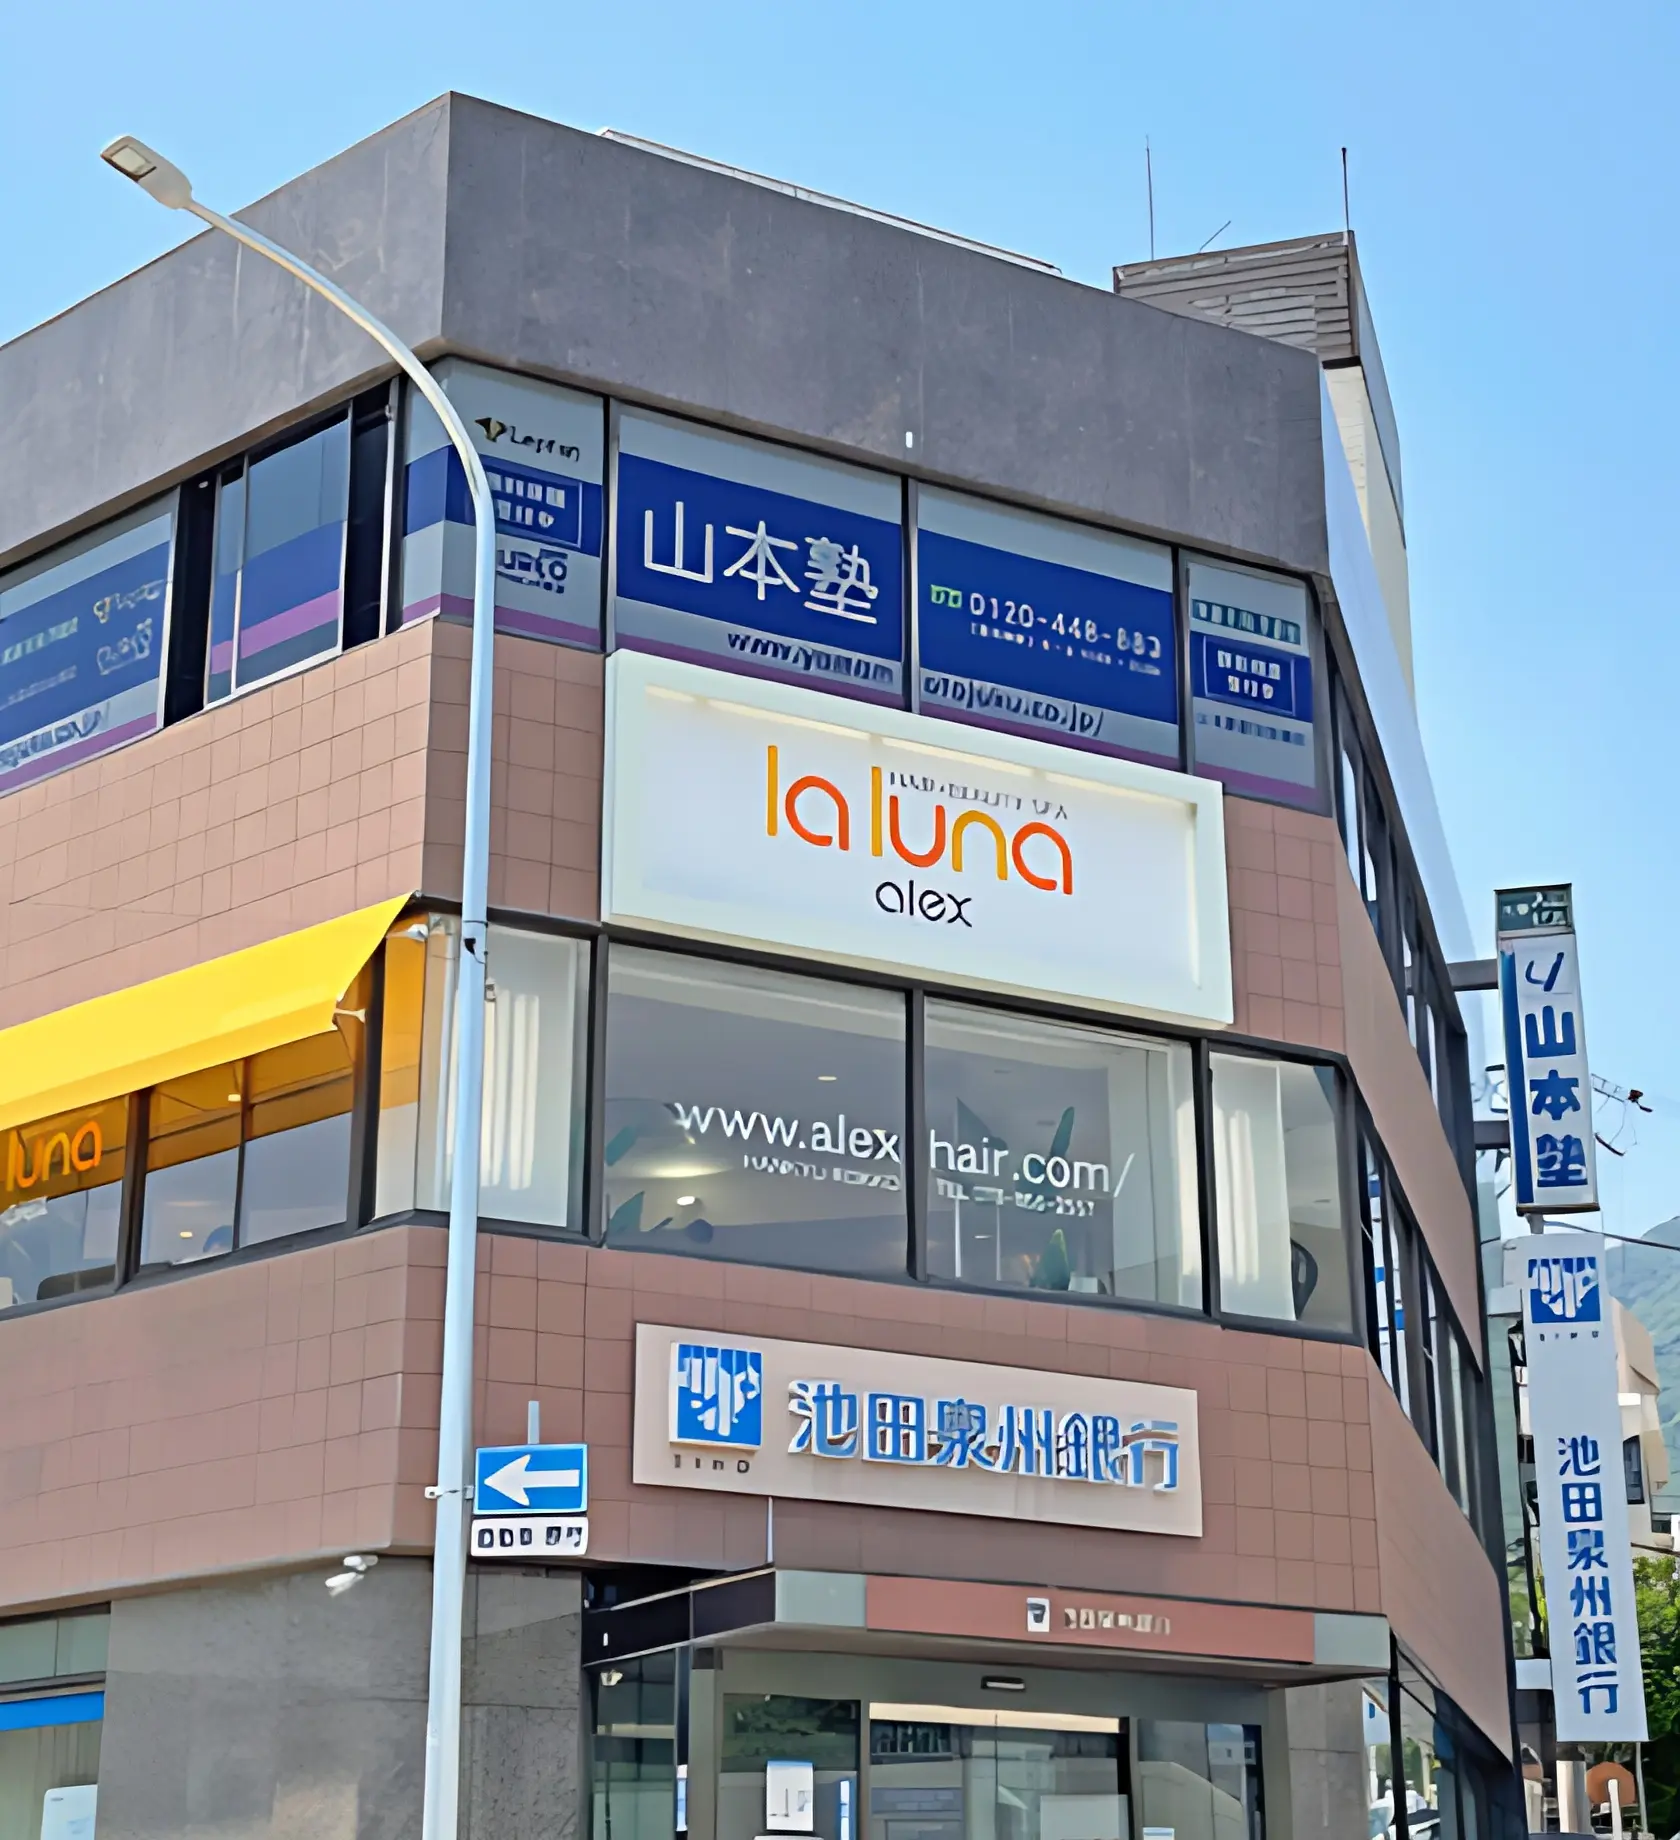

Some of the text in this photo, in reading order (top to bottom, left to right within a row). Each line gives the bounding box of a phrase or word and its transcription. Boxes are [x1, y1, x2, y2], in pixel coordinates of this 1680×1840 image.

[643, 500, 880, 625] 山本塾
[767, 745, 849, 851] la
[871, 766, 1073, 895] luna
[875, 879, 973, 928] alex
[788, 1379, 1180, 1493] 池田泉州銀行
[1556, 1434, 1620, 1716] 池田泉州銀行
